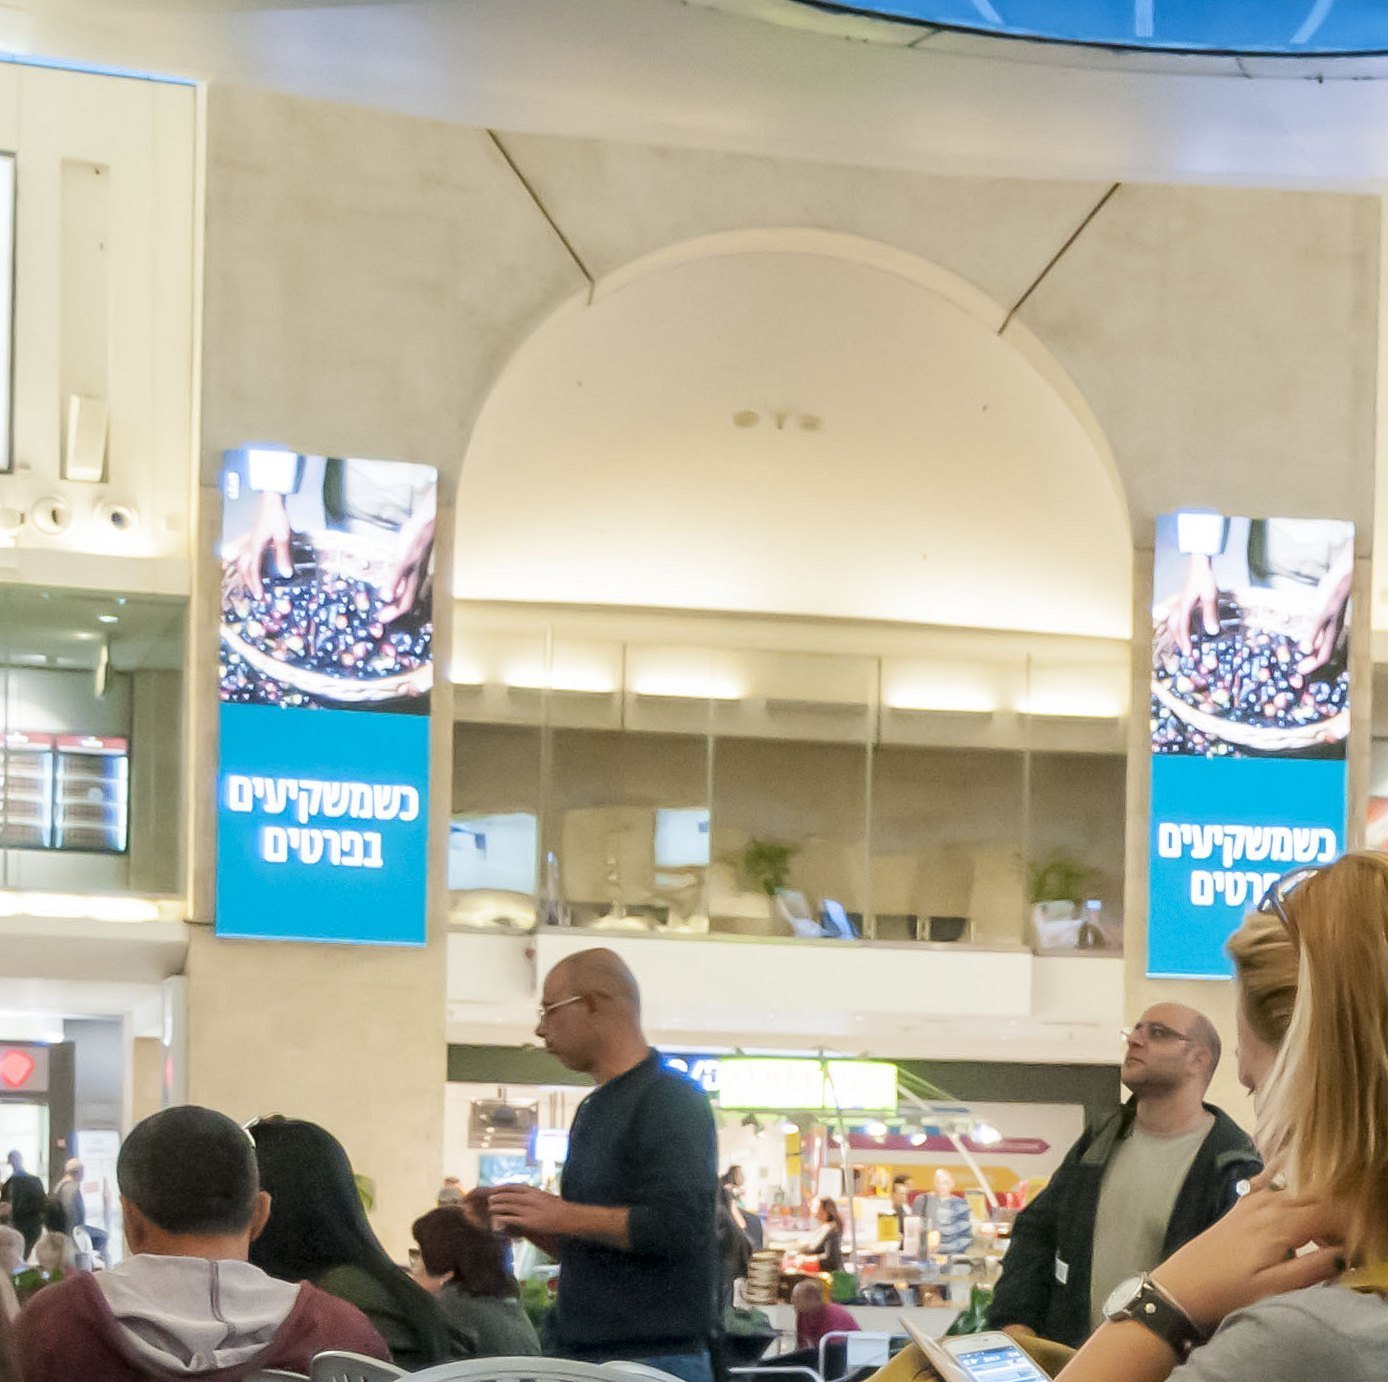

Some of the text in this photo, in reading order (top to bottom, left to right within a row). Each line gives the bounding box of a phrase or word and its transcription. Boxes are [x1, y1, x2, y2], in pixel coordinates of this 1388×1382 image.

[228, 775, 419, 824] כשמשקיעים
[263, 825, 383, 868] בפרטים
[1158, 822, 1336, 868] כשמשקיעים
[1190, 870, 1281, 907] רטים
